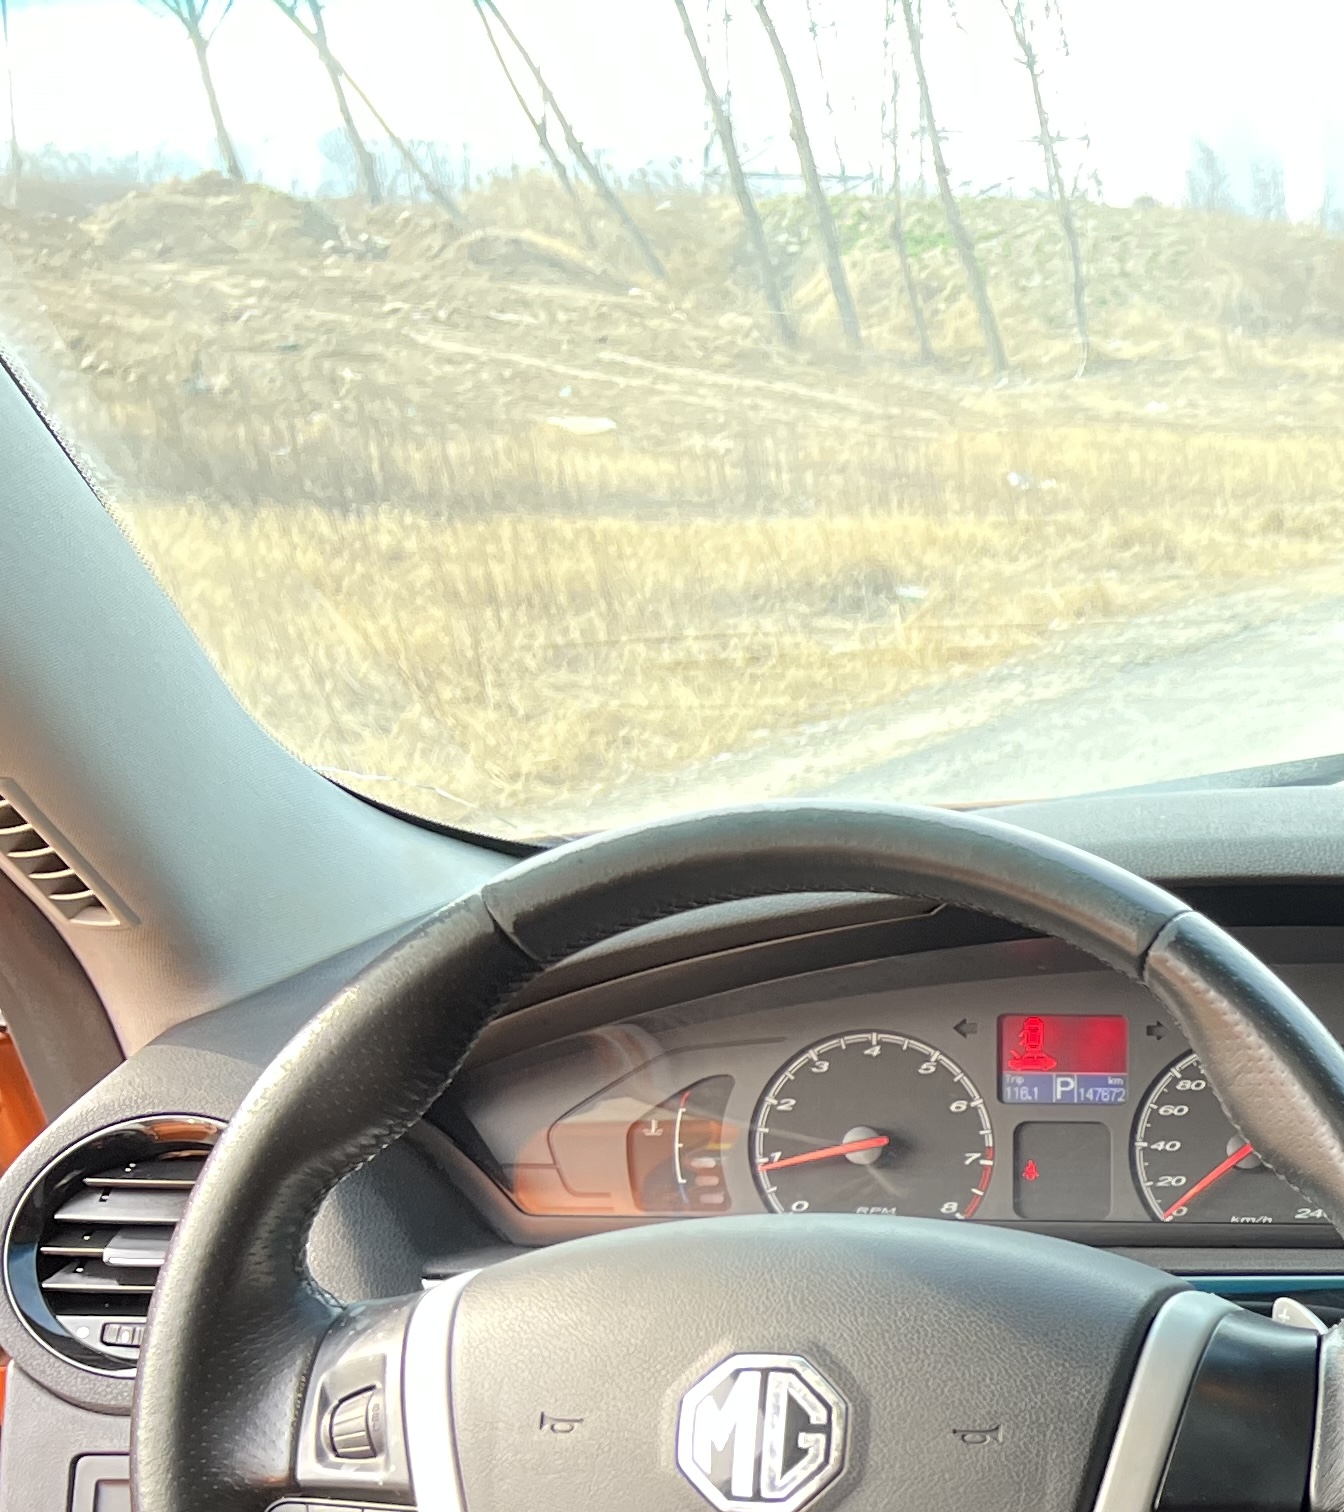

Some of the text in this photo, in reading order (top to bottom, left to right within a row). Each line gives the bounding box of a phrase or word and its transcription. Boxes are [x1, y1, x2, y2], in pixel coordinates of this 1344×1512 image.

[864, 1045, 881, 1057] 4
[811, 1061, 830, 1073] 3
[917, 1061, 937, 1074] 5
[1107, 1076, 1124, 1085] km
[1176, 1080, 1207, 1091] 80
[1056, 1077, 1075, 1100] P
[776, 1099, 797, 1111] 2
[949, 1100, 968, 1112] 6
[1158, 1105, 1190, 1116] 60
[1150, 1140, 1181, 1151] 40
[965, 1152, 981, 1165] 7
[1156, 1175, 1187, 1187] 20
[791, 1200, 810, 1212] 0
[856, 1206, 897, 1215] RPM
[940, 1201, 958, 1214] 8
[1294, 1207, 1324, 1219] 24
[1230, 1215, 1273, 1224] km/h
[691, 1370, 829, 1499] MG
